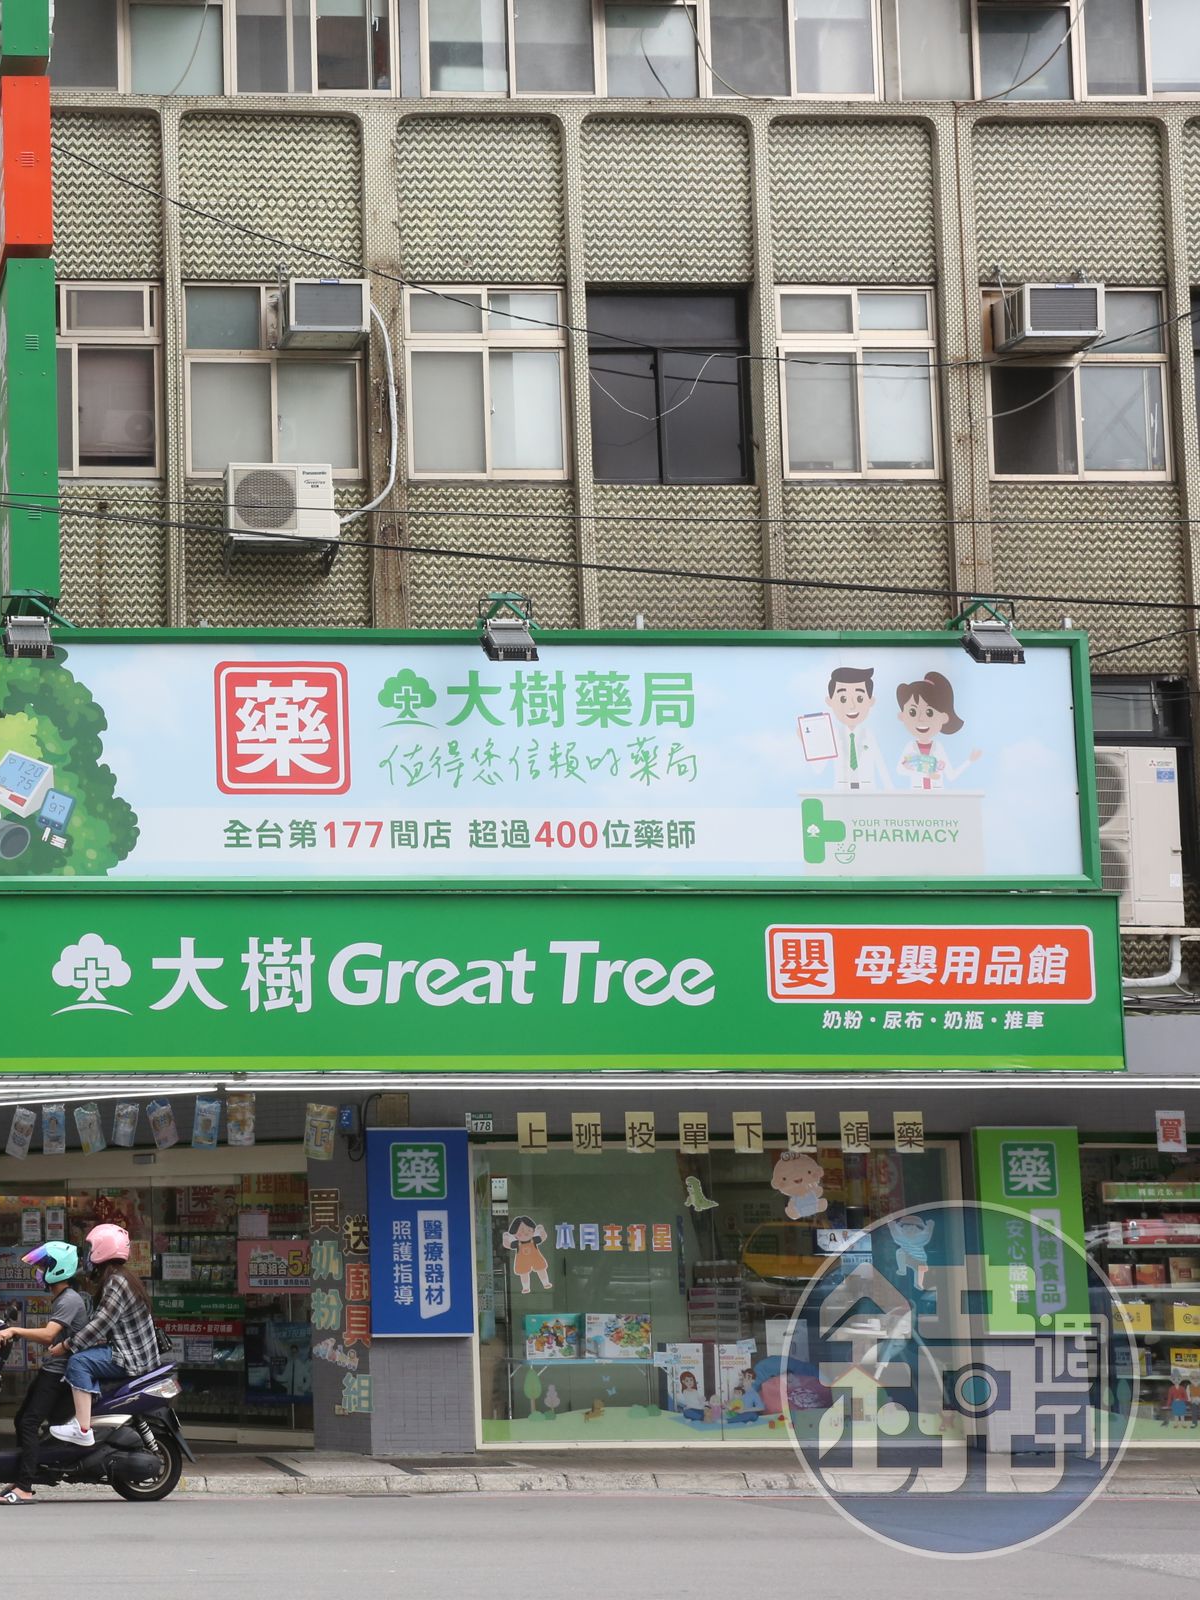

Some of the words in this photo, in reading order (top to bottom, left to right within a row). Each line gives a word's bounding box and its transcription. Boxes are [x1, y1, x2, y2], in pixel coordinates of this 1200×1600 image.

[445, 670, 696, 729] 大樹藥局
[235, 680, 332, 776] 藥
[378, 736, 698, 788] 值得您信賴的藥局
[48, 802, 65, 815] 97
[851, 819, 880, 827] YOUR
[884, 819, 959, 827] TRUSTWORTHY
[223, 819, 453, 849] 全台第177間店
[468, 819, 696, 849] 超過400位藥師
[853, 829, 959, 842] PHARMACY
[149, 936, 315, 1013] 大樹
[327, 942, 536, 1006] Great
[548, 940, 716, 1006] Tree
[780, 939, 829, 988] 嬰
[855, 944, 1069, 985] 母嬰用品館
[474, 1121, 491, 1131] 178
[1160, 1118, 1182, 1144] 買
[397, 1148, 441, 1194] 藥
[1008, 1148, 1051, 1193] 藥
[555, 1223, 672, 1252] 本月主打星
[392, 1221, 413, 1306] 照護指導
[423, 1220, 445, 1306] 醫療器材
[1006, 1220, 1029, 1304] 安心嚴選
